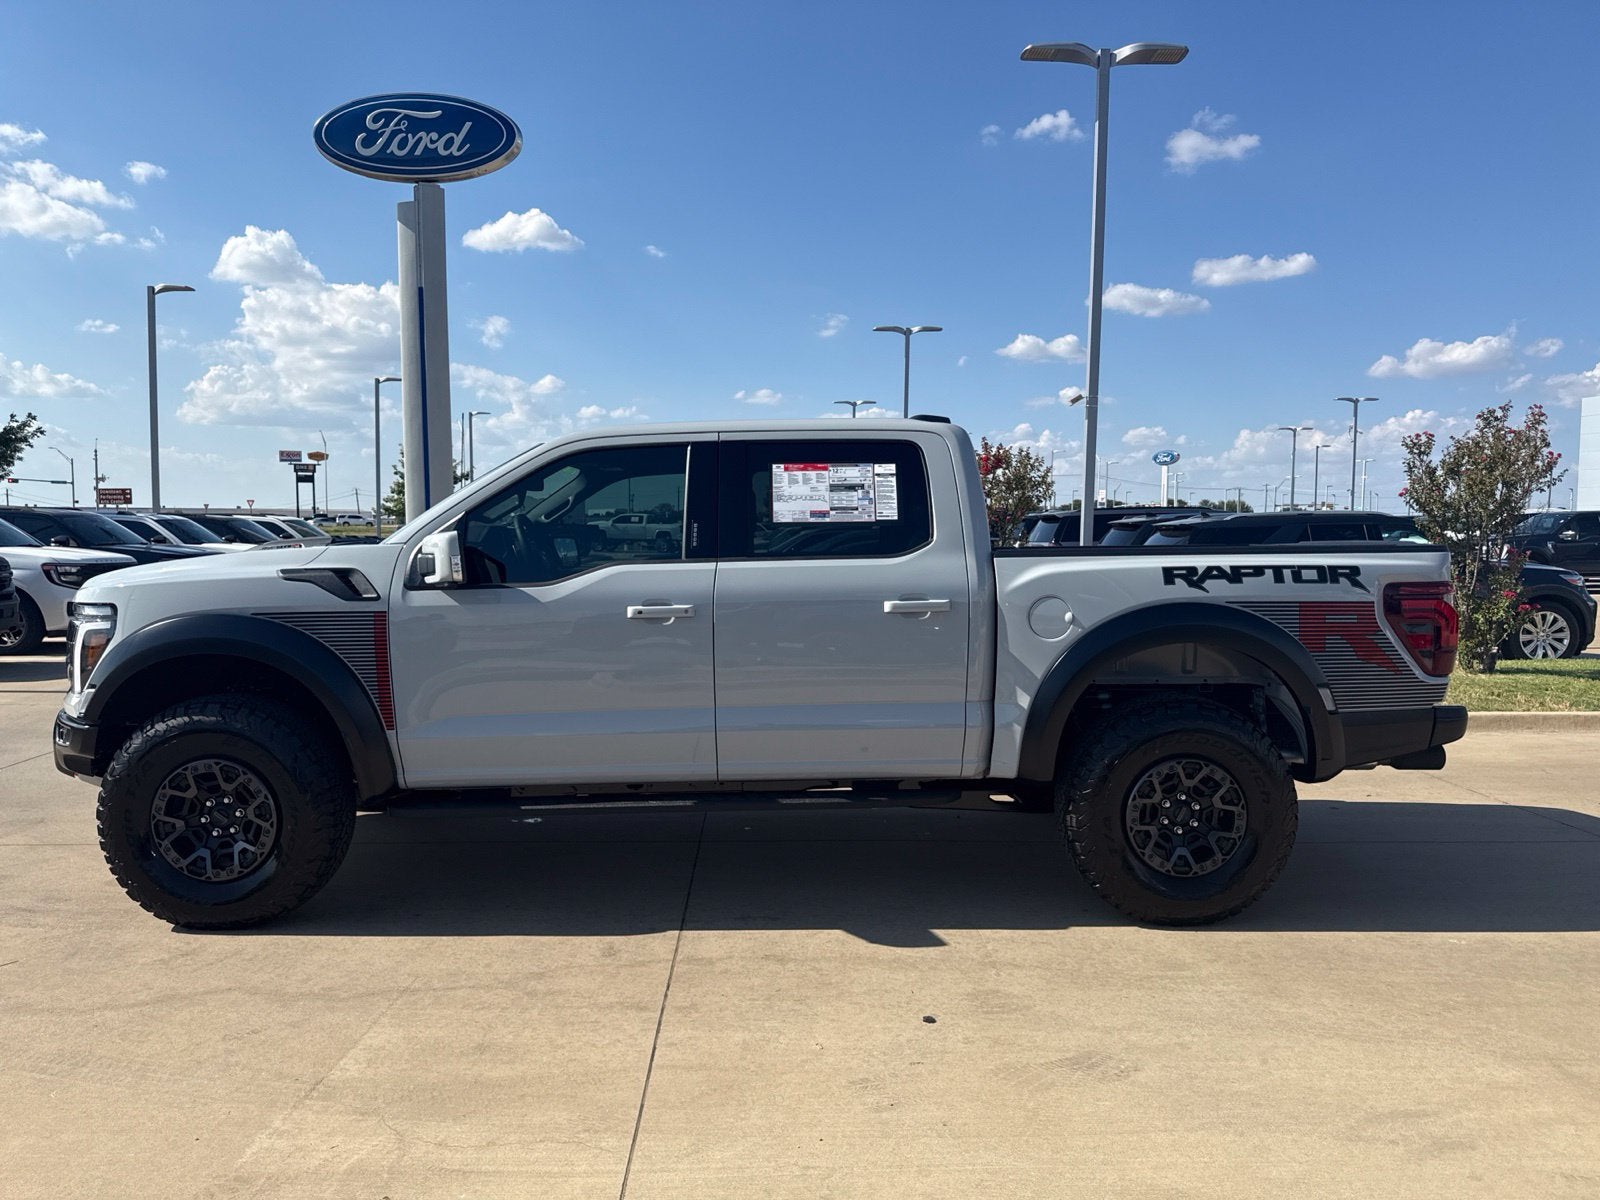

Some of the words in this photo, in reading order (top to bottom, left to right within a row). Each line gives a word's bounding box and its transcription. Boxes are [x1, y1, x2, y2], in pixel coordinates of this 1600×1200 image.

[355, 108, 472, 156] Ford
[1156, 453, 1172, 462] Ford
[1162, 565, 1371, 593] RAPTOR
[1299, 601, 1401, 675] R
